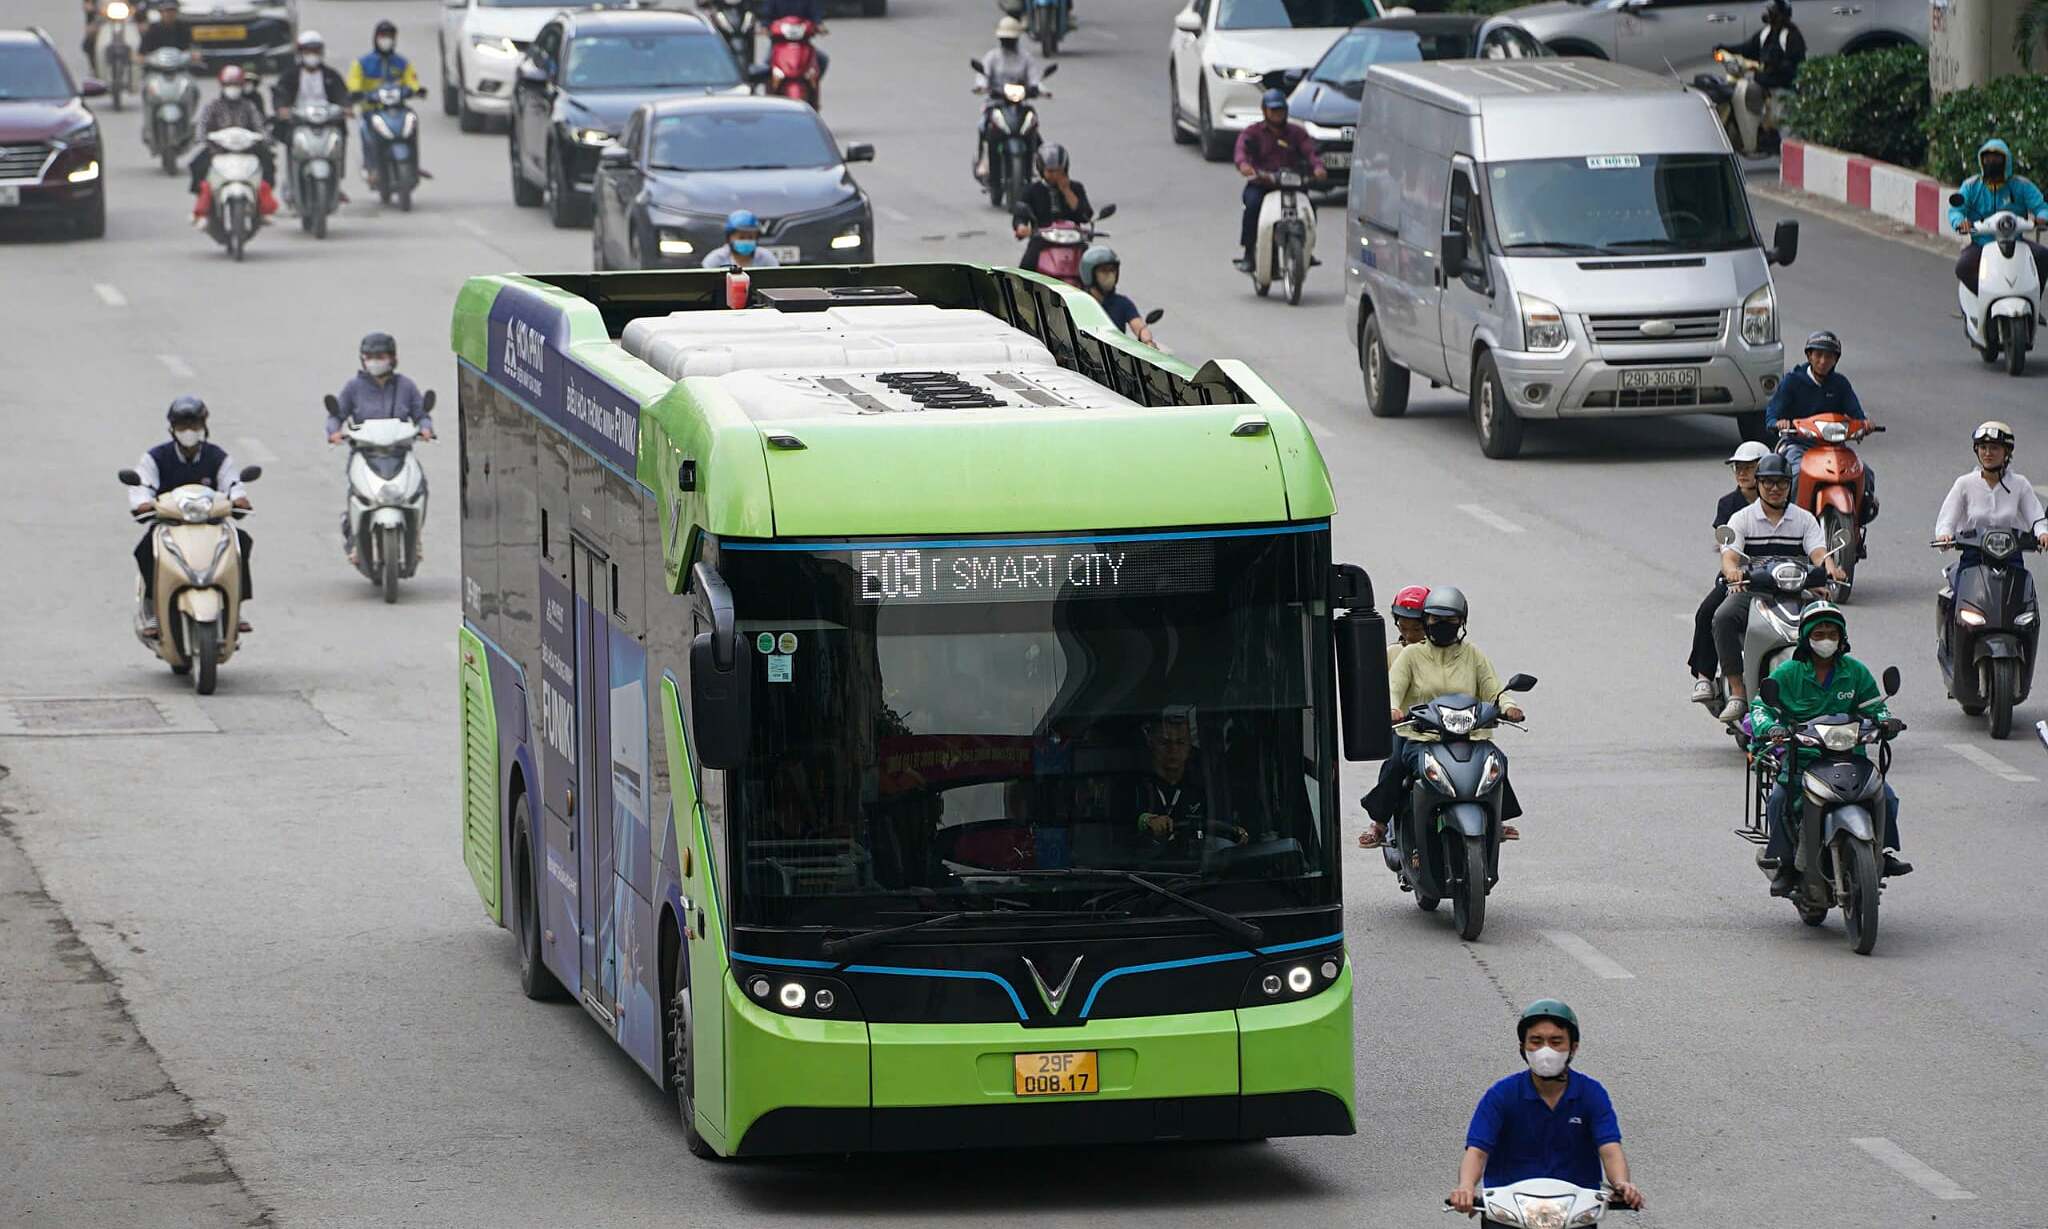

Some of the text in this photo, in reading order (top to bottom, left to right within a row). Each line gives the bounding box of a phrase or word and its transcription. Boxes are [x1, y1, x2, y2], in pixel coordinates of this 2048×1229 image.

[861, 549, 922, 598] E09
[952, 555, 1057, 590] SMART
[1068, 552, 1125, 587] CITY
[1038, 1054, 1074, 1073] 29F
[1024, 1073, 1089, 1093] 008.17
